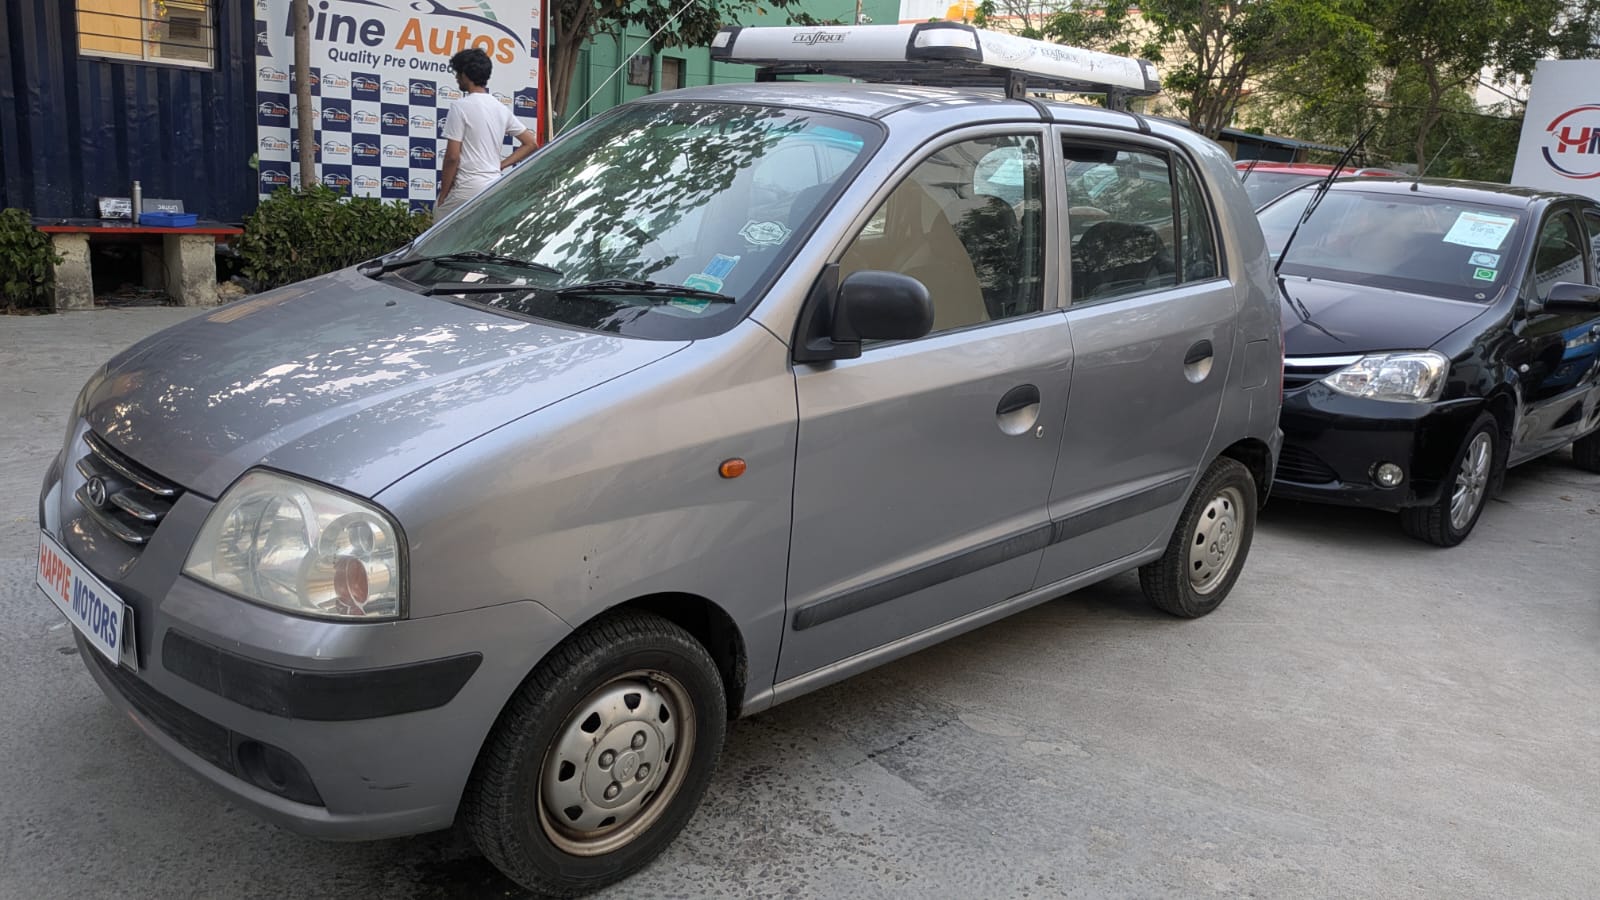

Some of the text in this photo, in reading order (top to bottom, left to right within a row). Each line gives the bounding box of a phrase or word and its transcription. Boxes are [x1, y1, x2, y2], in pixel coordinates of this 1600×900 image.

[328, 48, 380, 69] Quality
[384, 54, 406, 68] Pre
[395, 18, 515, 64] Autos
[40, 543, 118, 648] HAPPIE MOTORS
